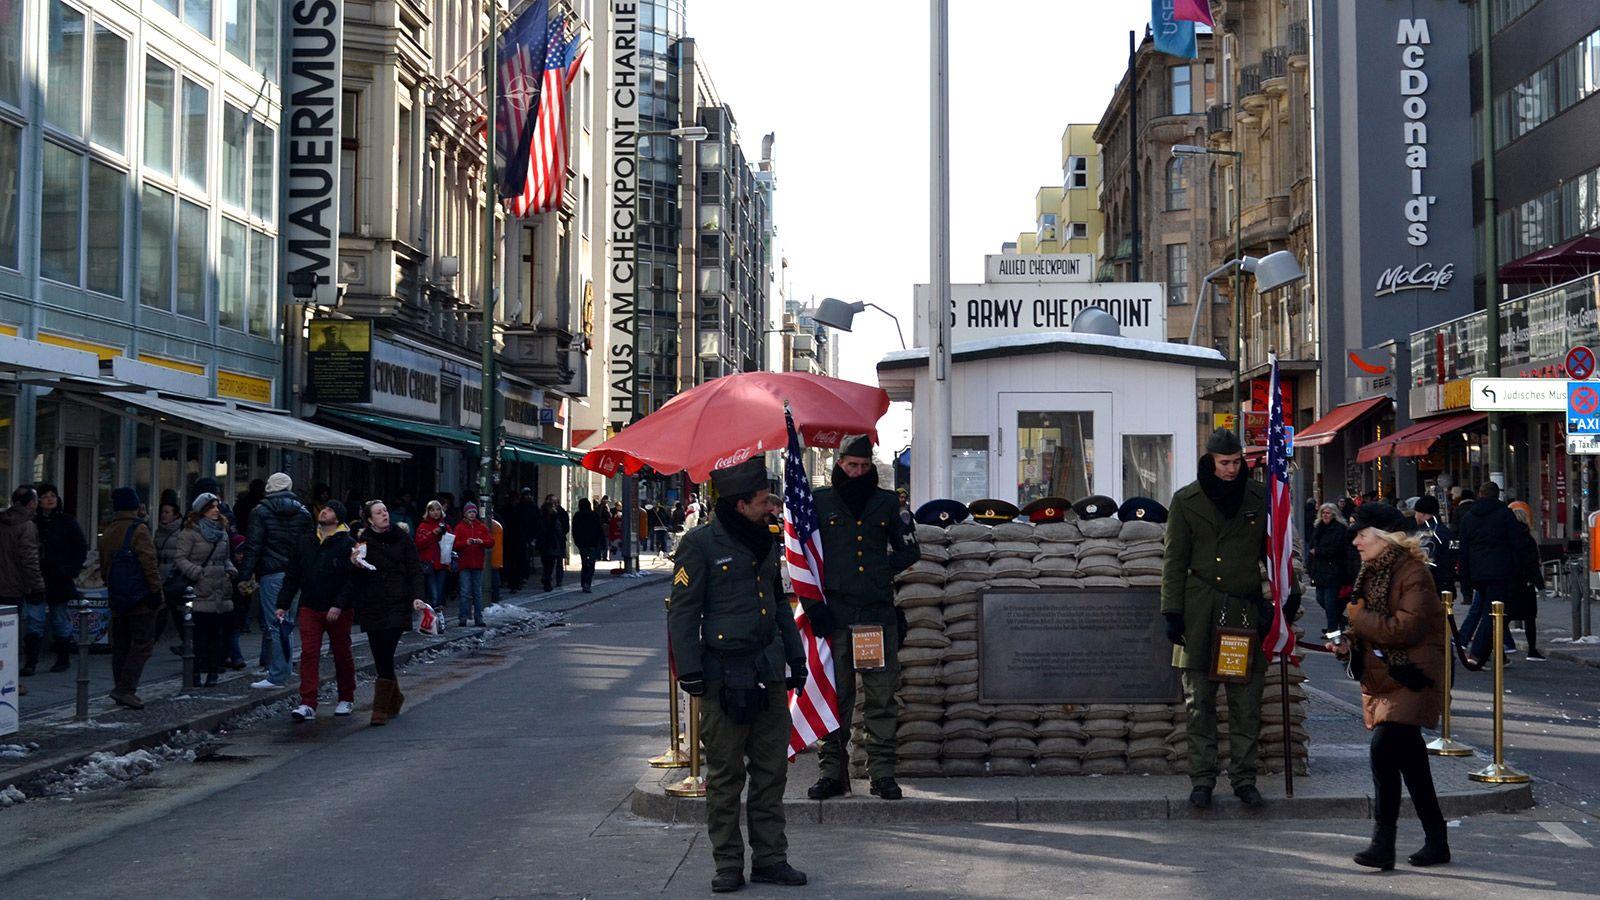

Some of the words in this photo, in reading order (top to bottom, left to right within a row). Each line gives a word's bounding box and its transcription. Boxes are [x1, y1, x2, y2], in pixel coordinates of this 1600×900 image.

[614, 3, 636, 109] CHARLIE
[1396, 18, 1436, 247] McDonald's
[613, 118, 635, 283] CHECKPOINT
[999, 260, 1026, 275] ALLIED
[1029, 259, 1081, 275] CHECKPOINT
[1375, 262, 1454, 293] McCafé
[612, 292, 633, 335] AM
[967, 299, 1023, 328] ARMY
[1033, 298, 1153, 328] CHECOINT
[611, 344, 633, 412] HAUS
[1548, 389, 1566, 399] Mus
[1569, 417, 1599, 429] TAXI
[1578, 440, 1598, 448] Taxen
